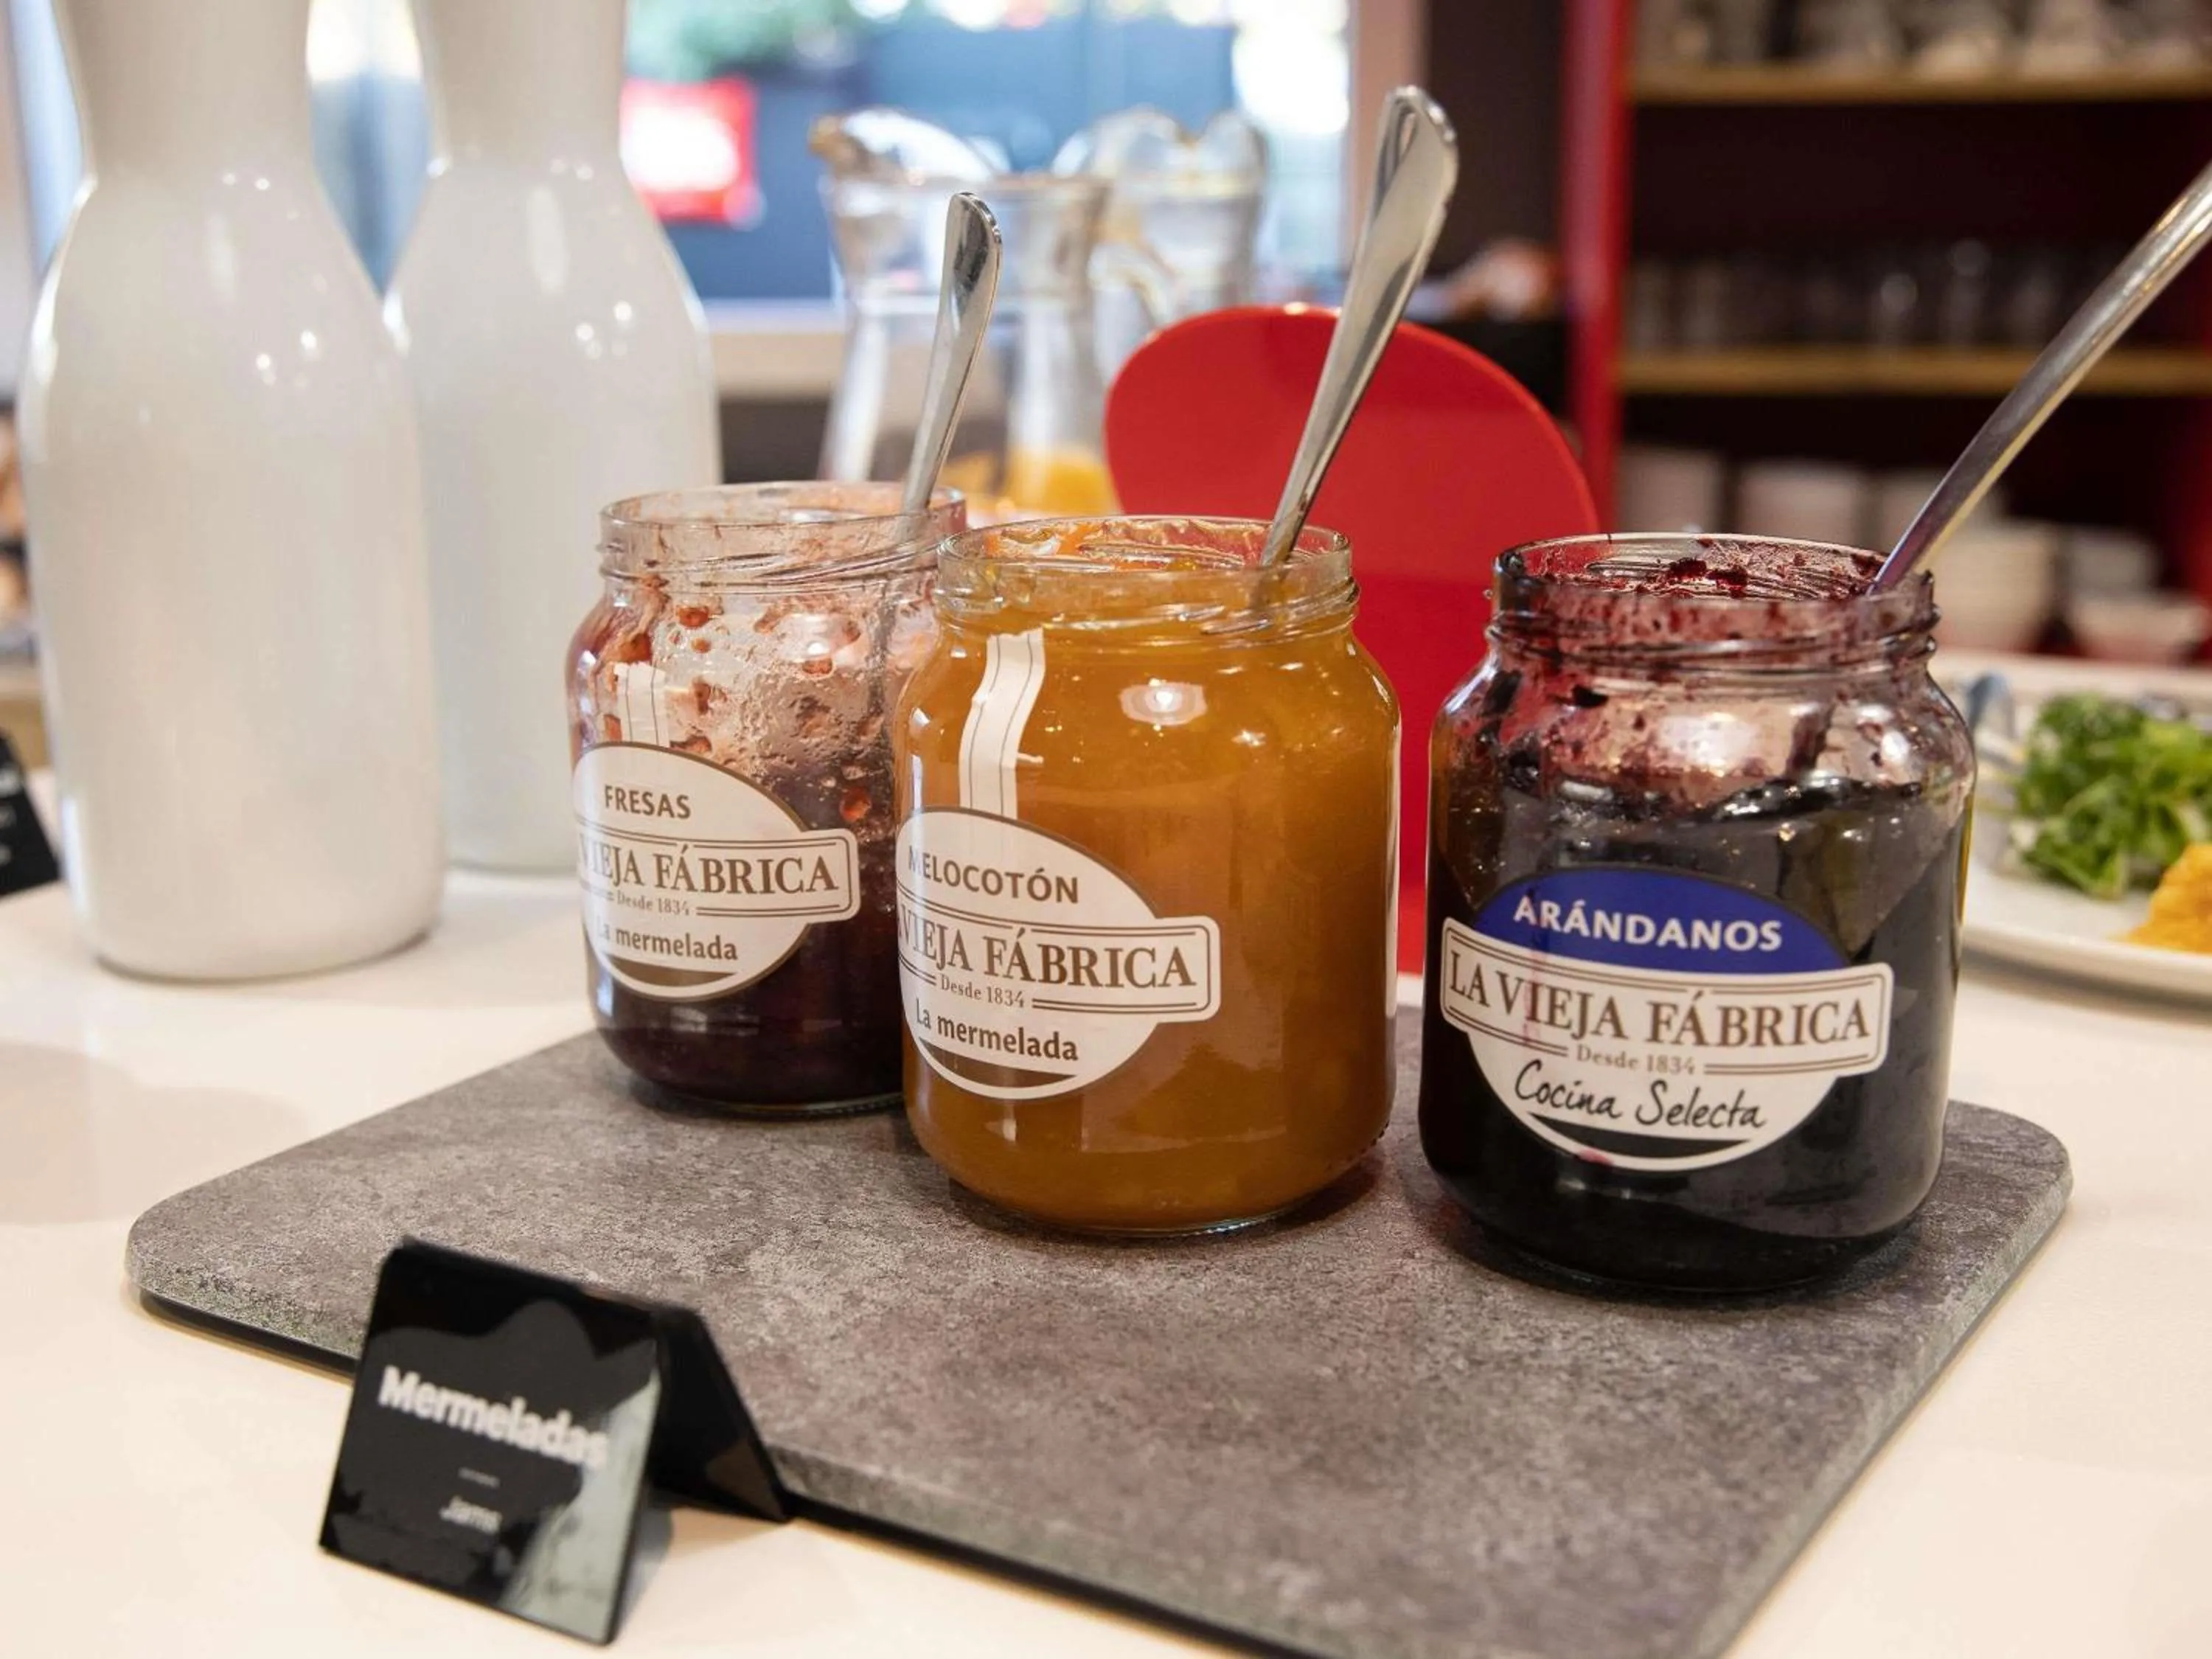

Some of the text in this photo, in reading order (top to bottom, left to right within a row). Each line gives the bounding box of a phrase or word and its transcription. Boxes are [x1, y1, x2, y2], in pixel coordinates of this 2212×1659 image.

[604, 785, 691, 819] FRESAS
[653, 844, 839, 895] FÁBRICA
[908, 845, 1079, 904] MELOCOTÓN
[616, 889, 690, 916] Desde 1834
[1512, 894, 1784, 952] ARÁNDANOS
[616, 927, 737, 961] mermelada
[900, 904, 1197, 989] VIEJA FÁBRICA
[940, 973, 1026, 1009] Desde 1834
[1450, 950, 1871, 1048] LA VIEJA FÁBRICA
[915, 997, 1079, 1062] La mermelada
[1576, 1043, 1696, 1077] Desde 1834
[1514, 1059, 1767, 1130] Cocina Selecta
[378, 1364, 609, 1468] Mermeladas
